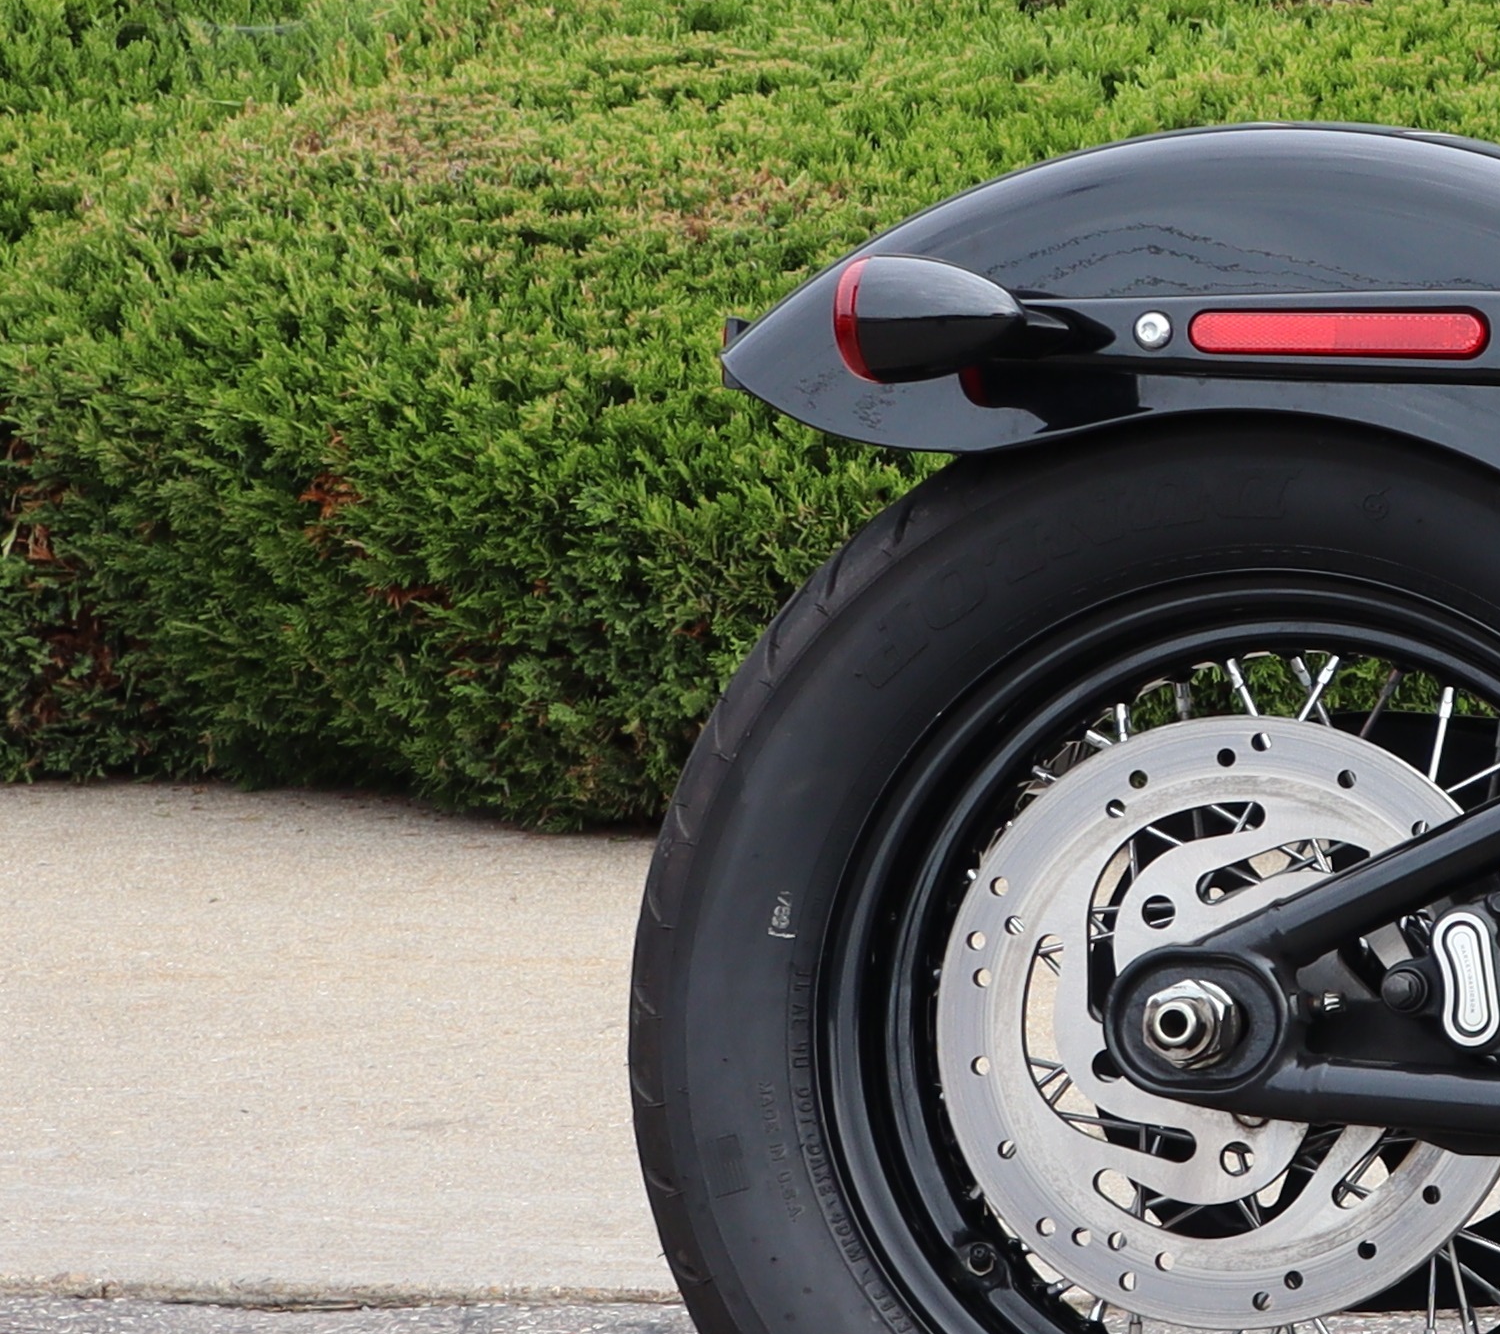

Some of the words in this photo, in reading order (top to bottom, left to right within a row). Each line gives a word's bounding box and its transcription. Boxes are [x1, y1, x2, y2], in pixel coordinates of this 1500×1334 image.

[856, 467, 1303, 689] DUNLOP
[758, 1080, 781, 1133] MADE
[793, 1085, 818, 1129] DOT
[769, 1141, 787, 1164] IN
